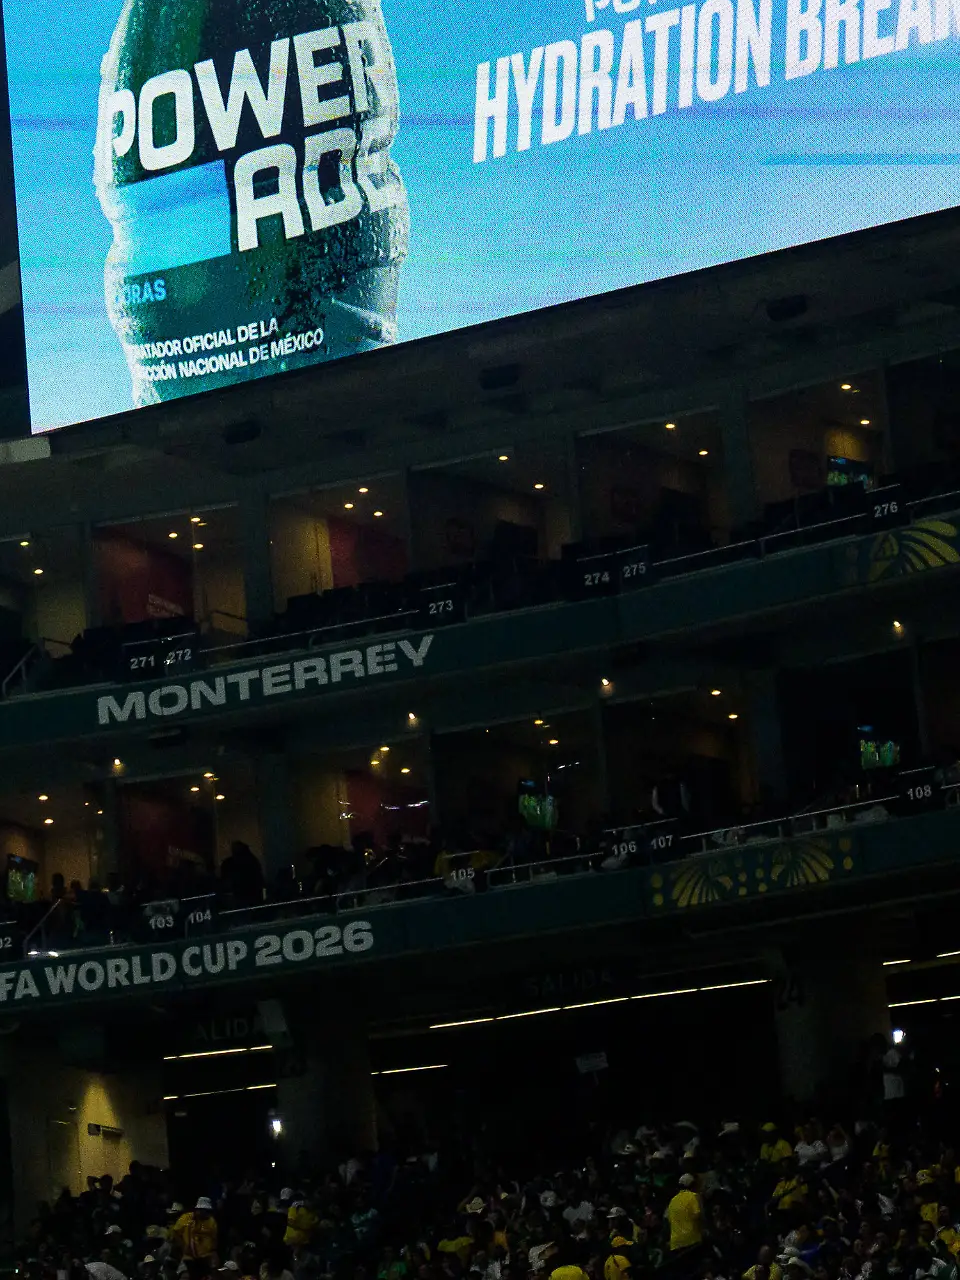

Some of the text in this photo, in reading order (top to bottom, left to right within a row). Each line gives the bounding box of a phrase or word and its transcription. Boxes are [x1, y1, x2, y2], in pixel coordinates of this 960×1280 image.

[183, 329, 237, 355] OFICIAL
[237, 324, 261, 343] DE
[260, 318, 280, 338] LA
[179, 354, 248, 379] NACIONAL
[249, 346, 270, 365] DE
[270, 328, 324, 360] MÉXICO
[873, 501, 899, 518] 276
[584, 571, 610, 587] 274
[622, 562, 647, 579] 275
[428, 599, 455, 616] 273
[129, 655, 156, 670] 271
[97, 635, 435, 725] MONTERREY
[906, 784, 933, 802] 108
[612, 839, 637, 857] 106
[650, 833, 675, 851] 107
[187, 909, 213, 925] 104
[44, 951, 177, 995] WORLD
[181, 939, 248, 977] CUP
[254, 920, 374, 967] 2026
